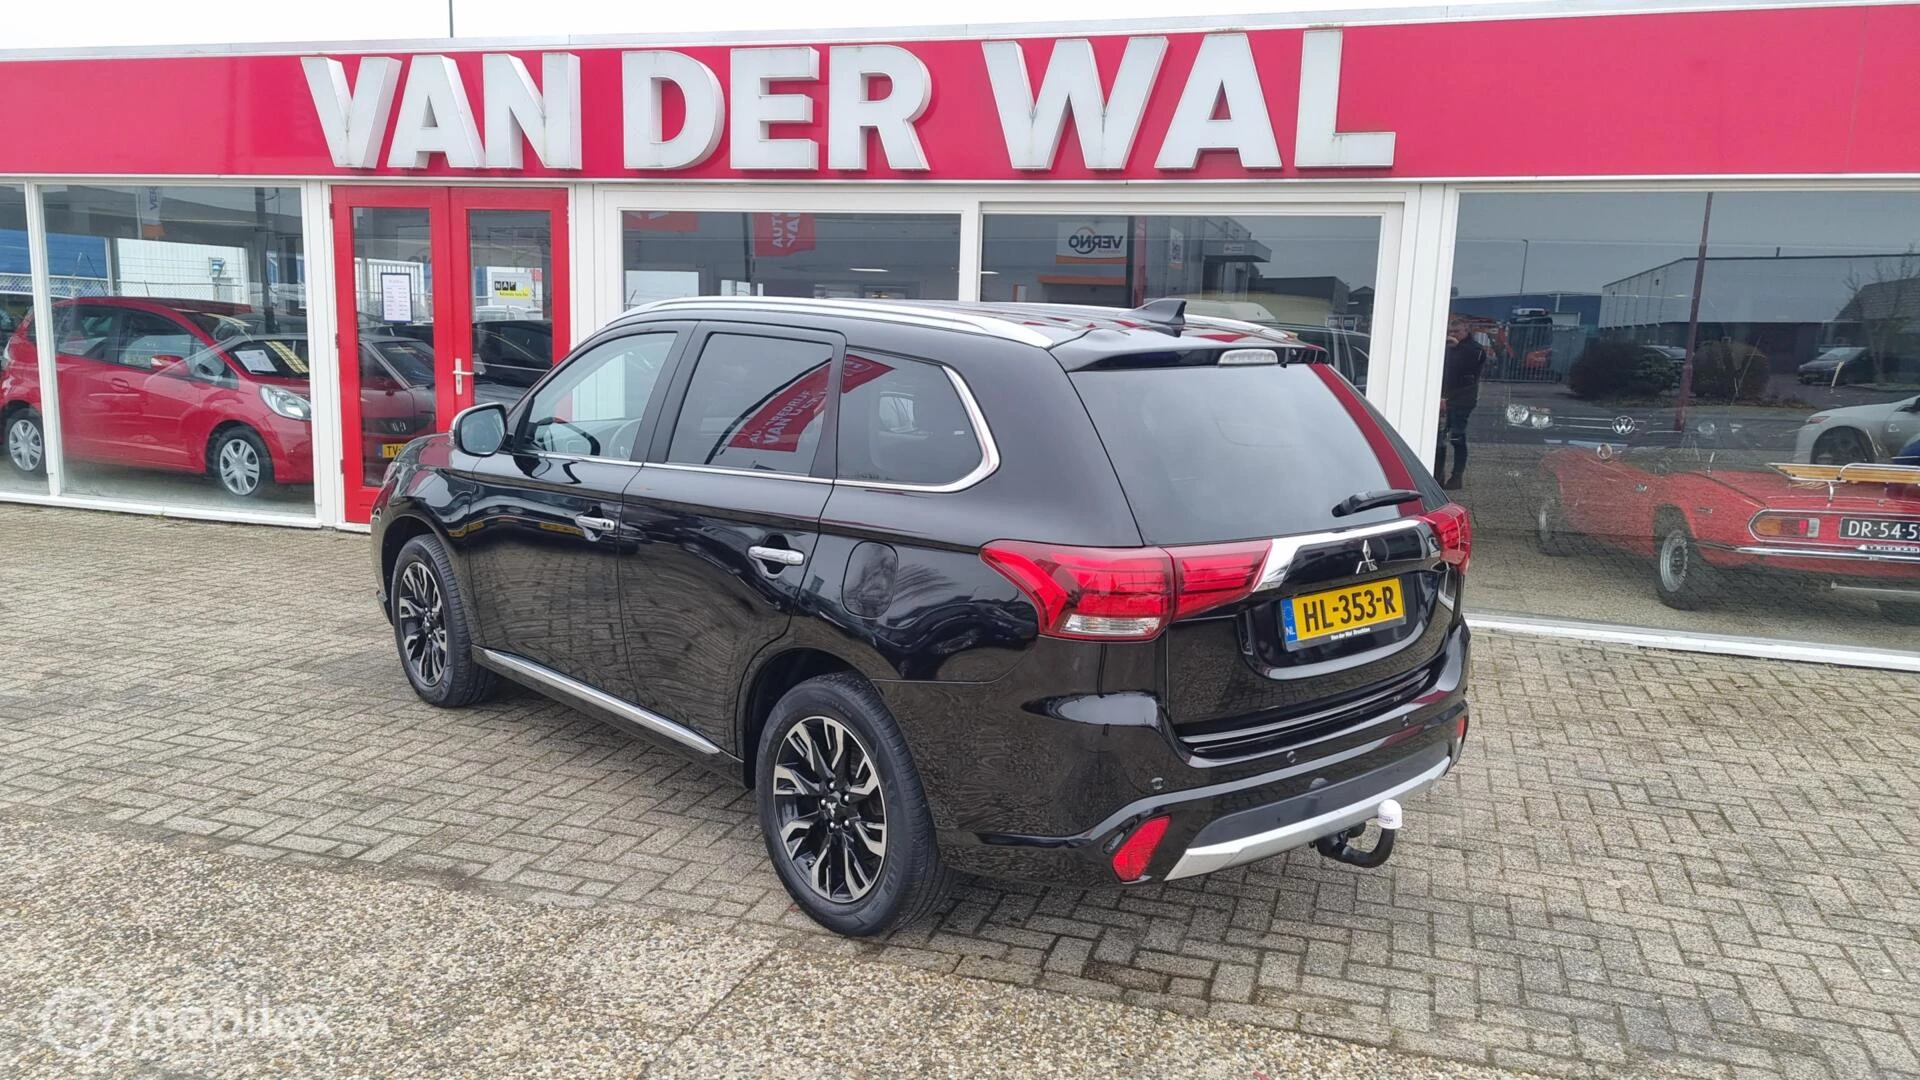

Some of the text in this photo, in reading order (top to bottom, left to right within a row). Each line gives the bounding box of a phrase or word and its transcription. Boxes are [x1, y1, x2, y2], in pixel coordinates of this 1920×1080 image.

[301, 29, 1396, 171] VAN DER WAL
[1848, 521, 1920, 540] DR-54-5
[1303, 586, 1397, 632] HL-353-R
[1285, 625, 1296, 636] NL
